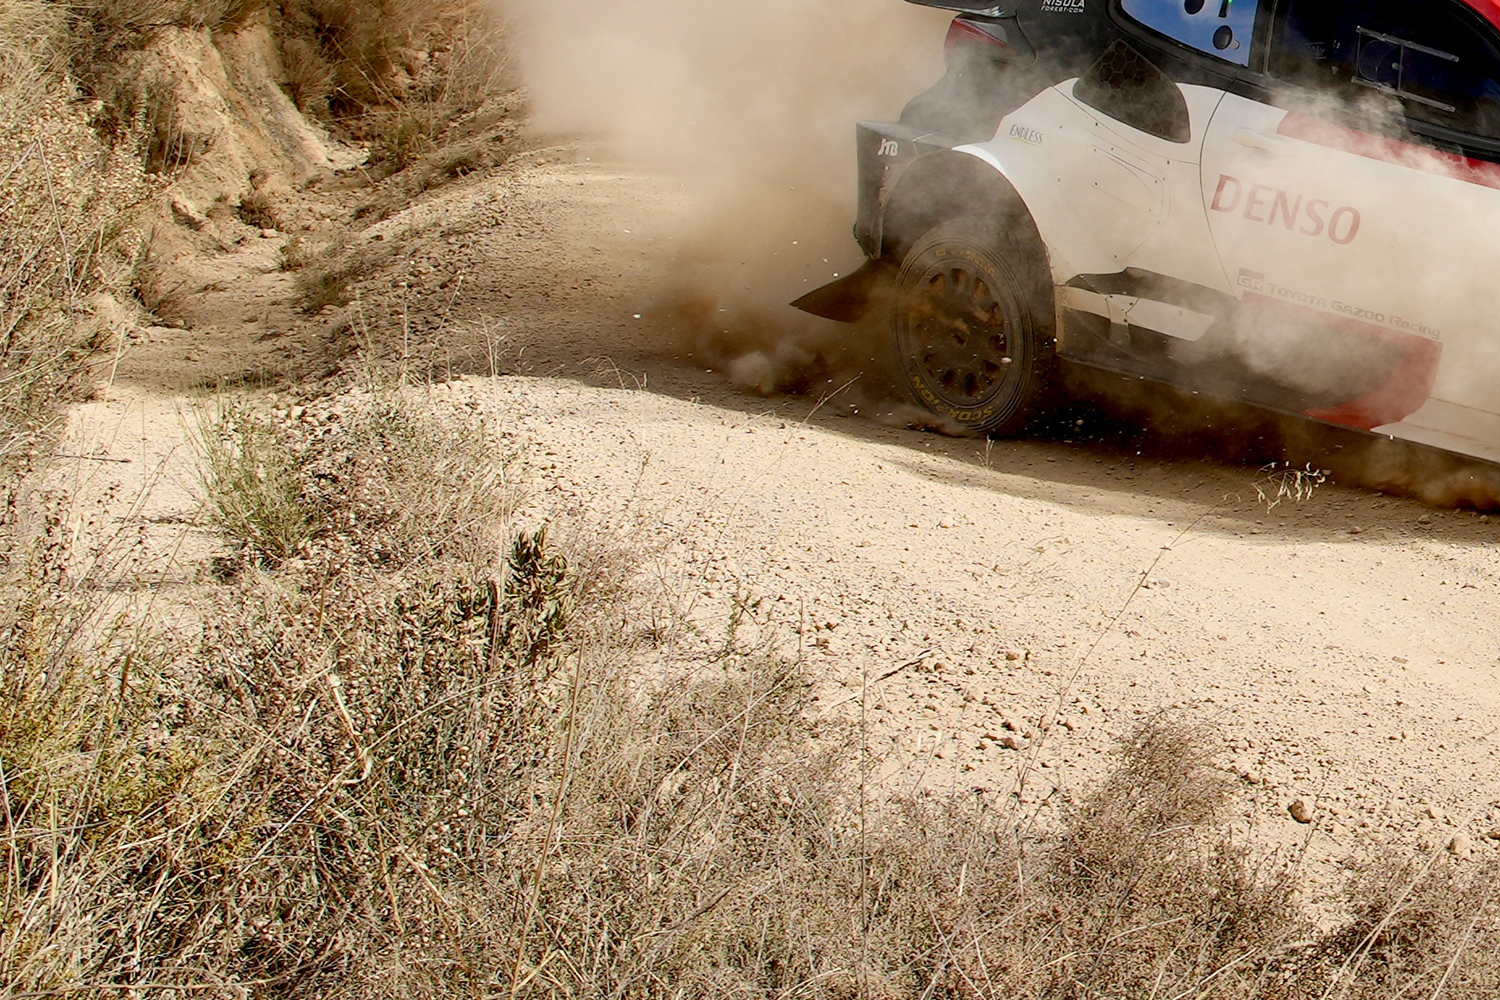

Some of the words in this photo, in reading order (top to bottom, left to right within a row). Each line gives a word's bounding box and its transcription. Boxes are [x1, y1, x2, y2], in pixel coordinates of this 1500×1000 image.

[1009, 123, 1044, 144] ENDLESS
[1210, 173, 1361, 245] DENSO
[1267, 282, 1327, 308] TOYOTA
[1331, 300, 1385, 323] GAZOO
[1389, 315, 1441, 340] Racing
